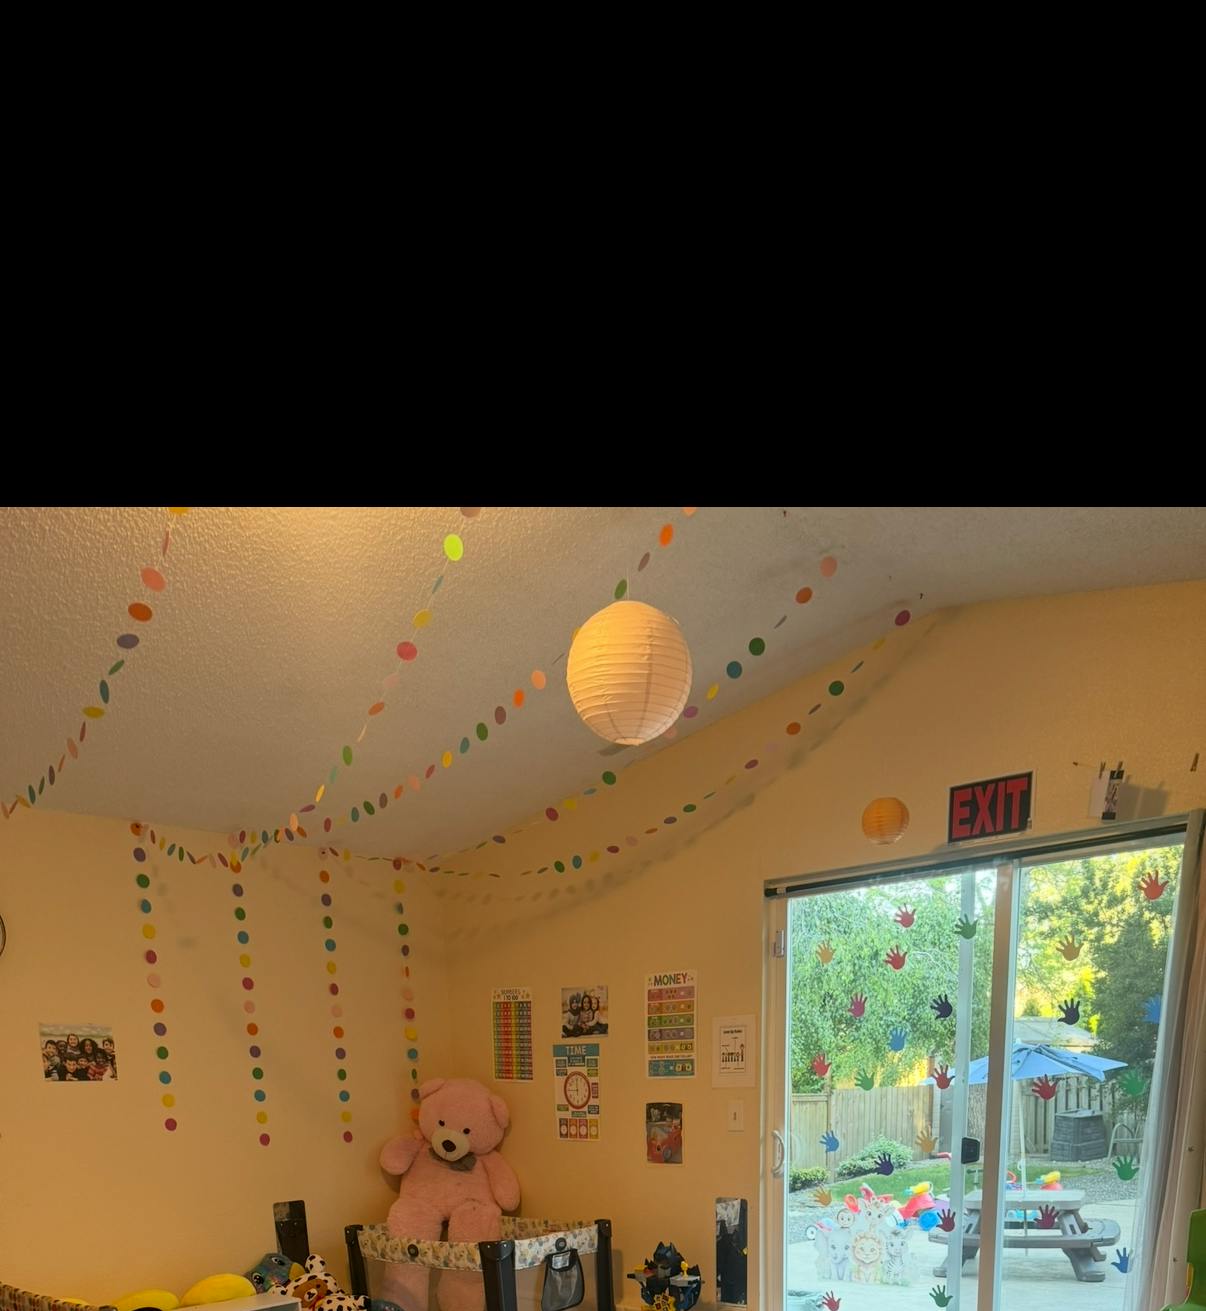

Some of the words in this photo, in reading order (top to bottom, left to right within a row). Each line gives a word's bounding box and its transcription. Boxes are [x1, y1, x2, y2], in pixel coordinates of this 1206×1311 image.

[952, 776, 1028, 839] EXIT
[653, 972, 688, 987] MONEY
[566, 1045, 588, 1056] TIME
